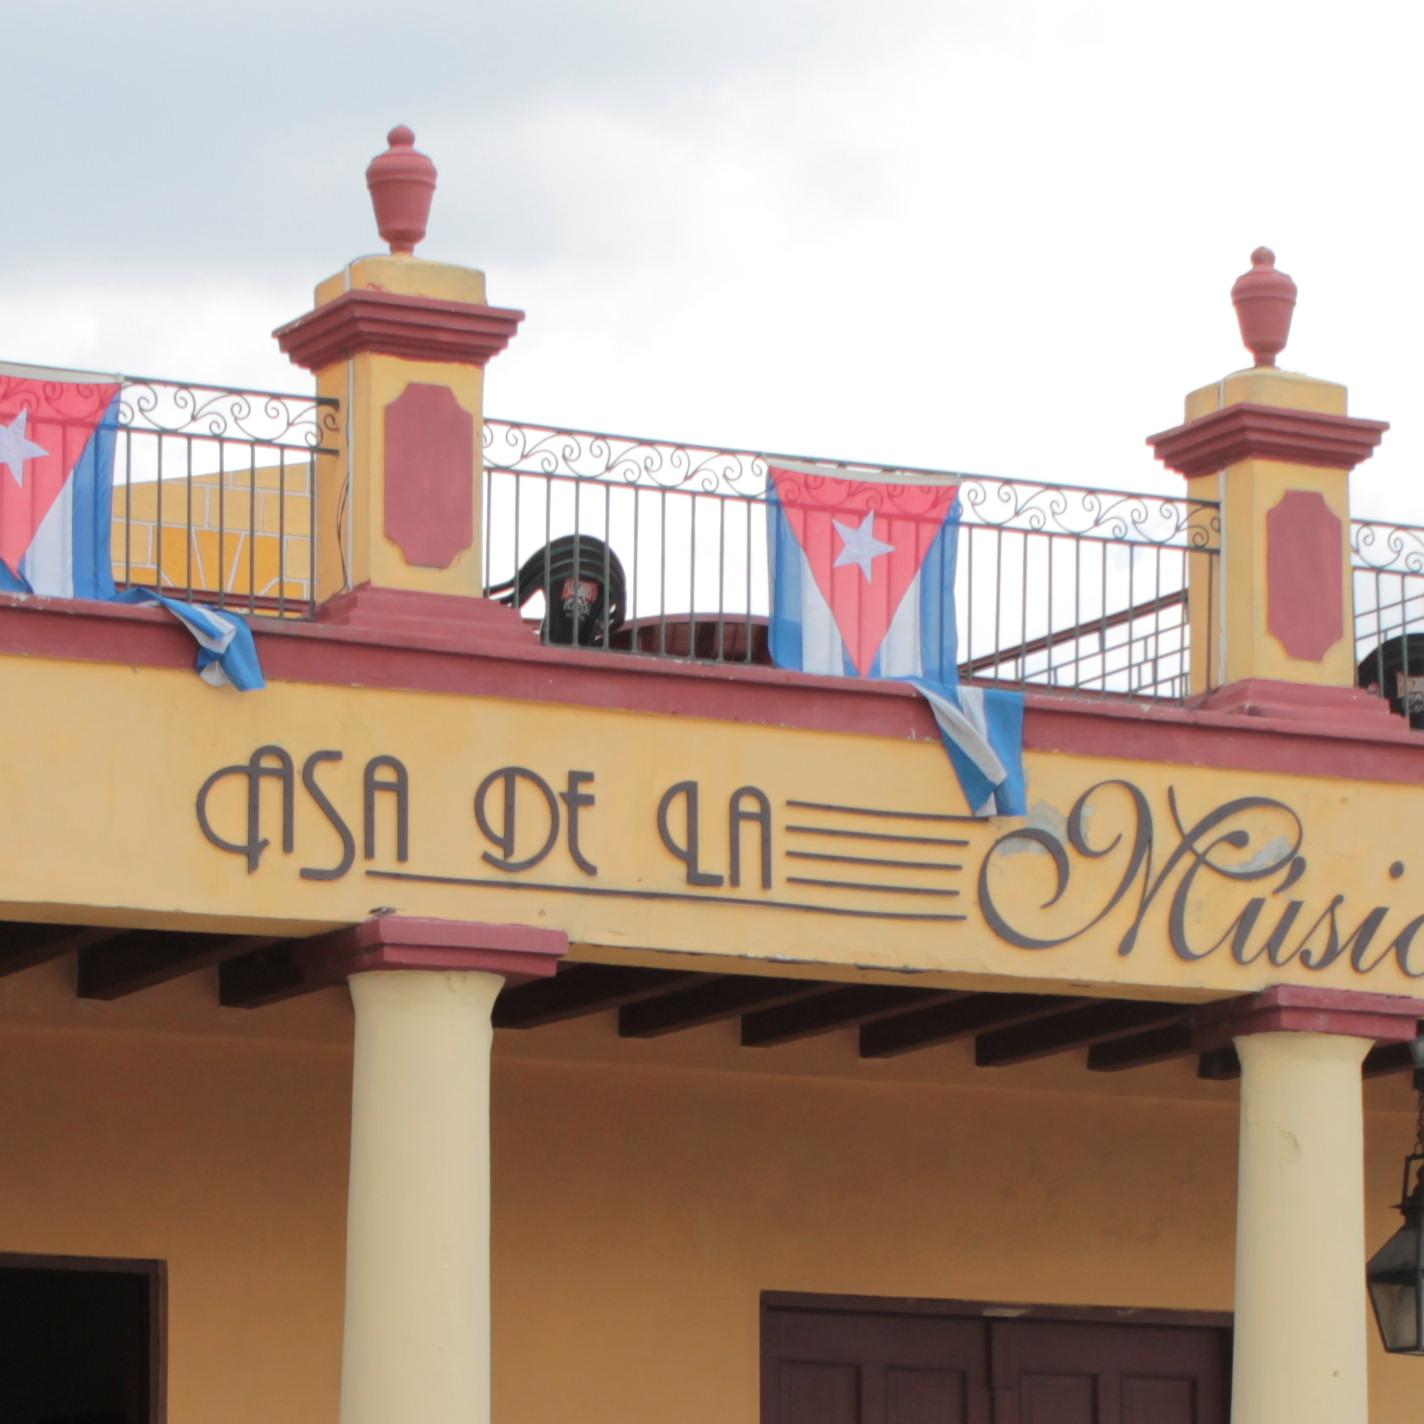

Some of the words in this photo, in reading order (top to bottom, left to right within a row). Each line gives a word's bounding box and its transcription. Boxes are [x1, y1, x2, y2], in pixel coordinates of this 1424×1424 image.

[195, 744, 408, 881] CASA
[475, 766, 598, 876] DE
[657, 780, 772, 890] LA
